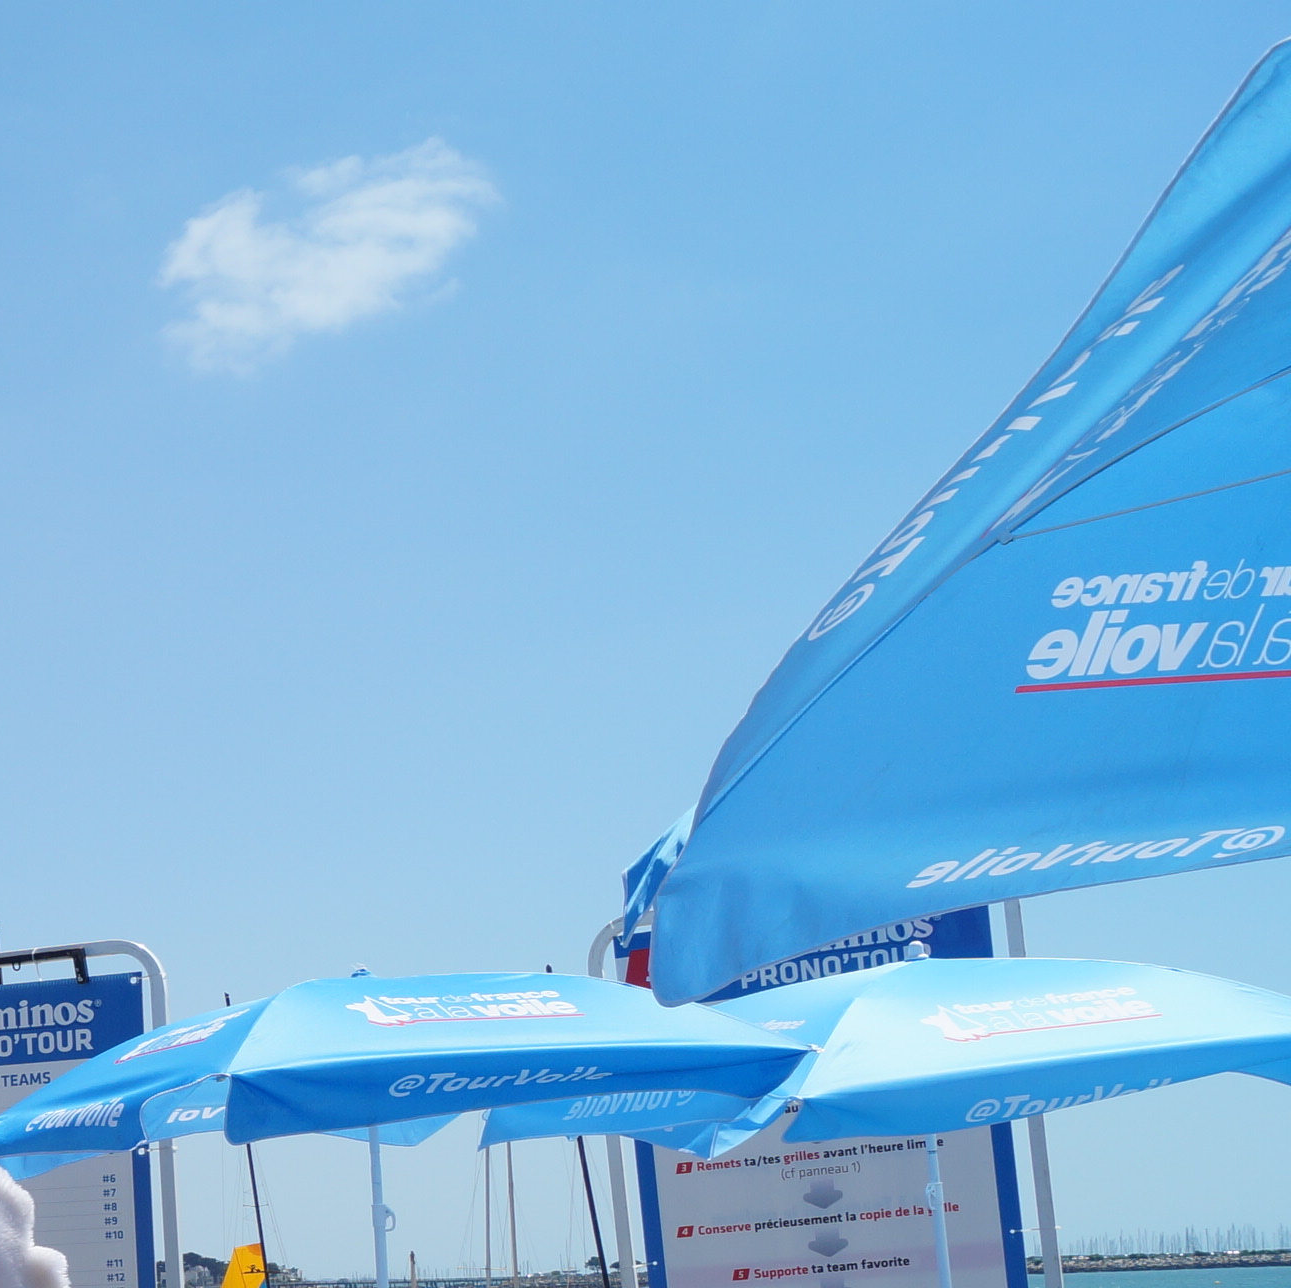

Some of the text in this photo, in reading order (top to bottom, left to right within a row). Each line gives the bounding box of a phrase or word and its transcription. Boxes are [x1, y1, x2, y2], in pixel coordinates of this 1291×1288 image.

[470, 990, 560, 1002] france
[470, 999, 578, 1017] voile
[1047, 999, 1157, 1023] voile
[1, 1072, 51, 1088] TEAMS
[388, 1066, 614, 1098] @TourVoile
[697, 1157, 741, 1171] Remets
[744, 1155, 781, 1167] ta/tes
[783, 1151, 820, 1165] grilles
[823, 1146, 857, 1159] avant
[860, 1142, 904, 1155] l'heure
[907, 1137, 944, 1150] lime
[102, 1174, 116, 1183] #6
[781, 1167, 796, 1181] (cf
[799, 1163, 849, 1180] panneau
[103, 1189, 116, 1197] #7
[104, 1203, 117, 1211] #8
[104, 1217, 118, 1225] #9
[698, 1222, 752, 1236] Conserve
[754, 1212, 843, 1232] précieusement
[846, 1211, 857, 1222] la
[860, 1208, 892, 1224] copie
[895, 1206, 910, 1218] de
[913, 1204, 925, 1216] la
[105, 1231, 124, 1239] #10
[106, 1259, 123, 1267] #11
[754, 1266, 809, 1280] Supporte
[811, 1264, 824, 1274] ta
[827, 1261, 858, 1273] team
[861, 1256, 910, 1270] favorite
[107, 1273, 125, 1281] #12
